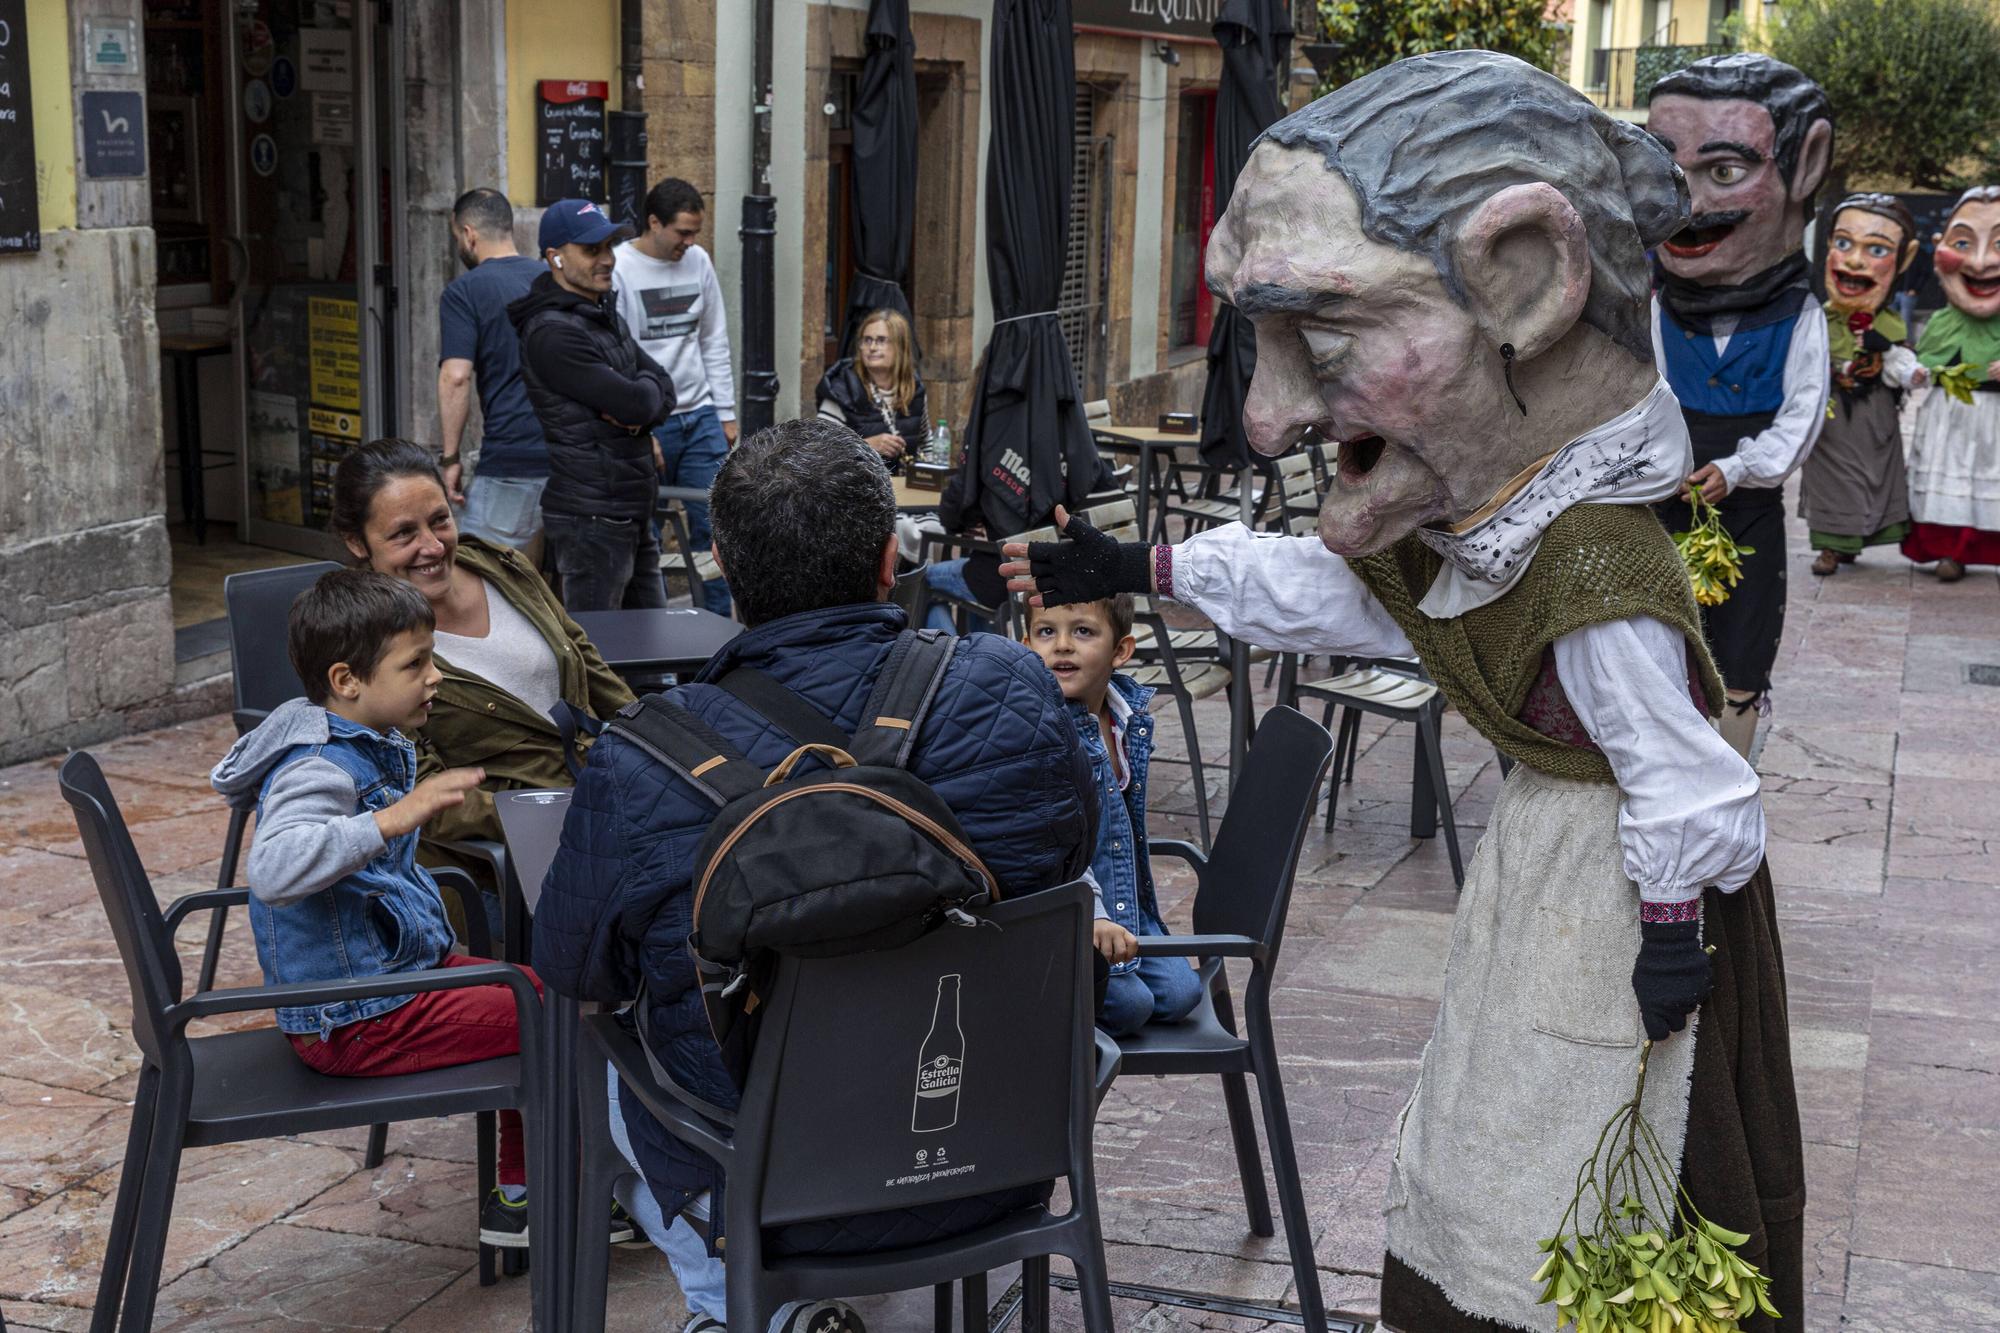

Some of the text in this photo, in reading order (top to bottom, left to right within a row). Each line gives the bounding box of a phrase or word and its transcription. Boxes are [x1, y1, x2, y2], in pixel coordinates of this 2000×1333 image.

[992, 466, 1025, 497] DESDE
[920, 1066, 960, 1080] Estrella
[920, 1076, 957, 1089] Galicia
